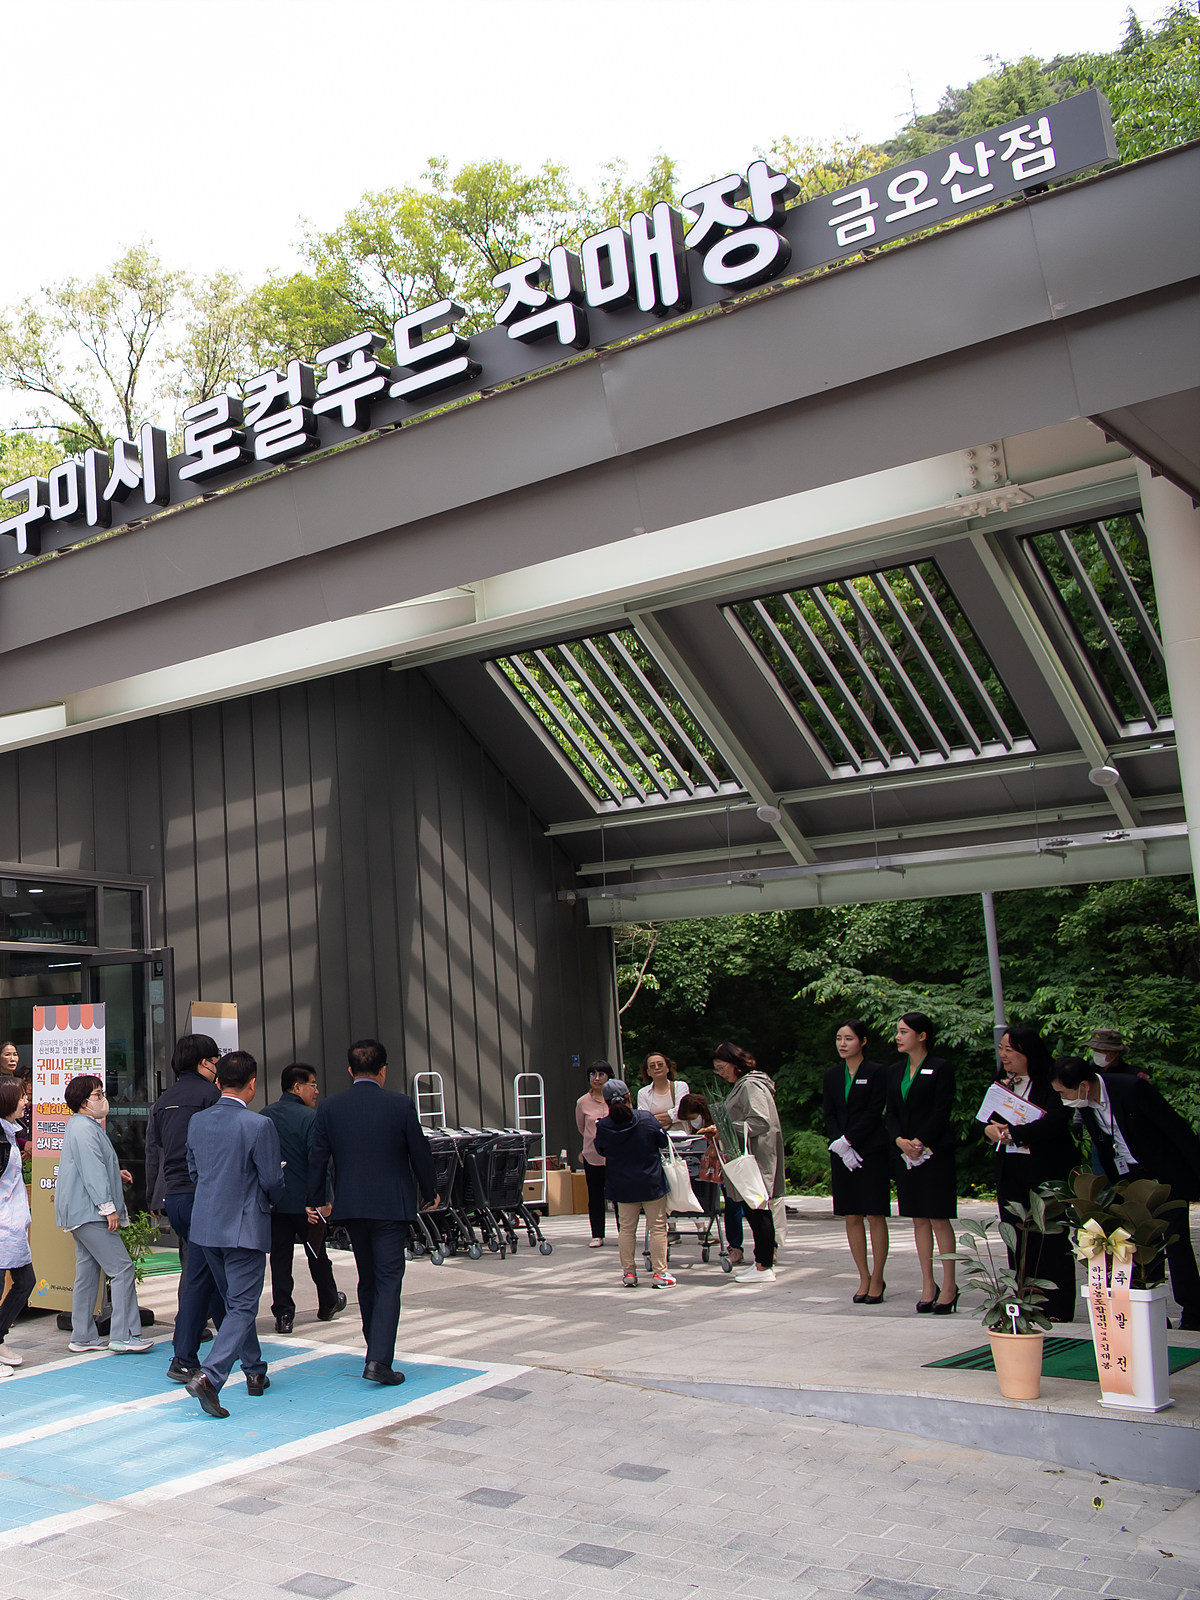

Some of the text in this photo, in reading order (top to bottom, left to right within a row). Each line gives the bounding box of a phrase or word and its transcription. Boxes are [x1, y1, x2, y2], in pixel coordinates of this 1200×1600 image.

[178, 298, 472, 481] 로컬푸드
[492, 159, 790, 346] 직매장
[828, 116, 1057, 249] 금오산점
[62, 1046, 79, 1054] 안전한
